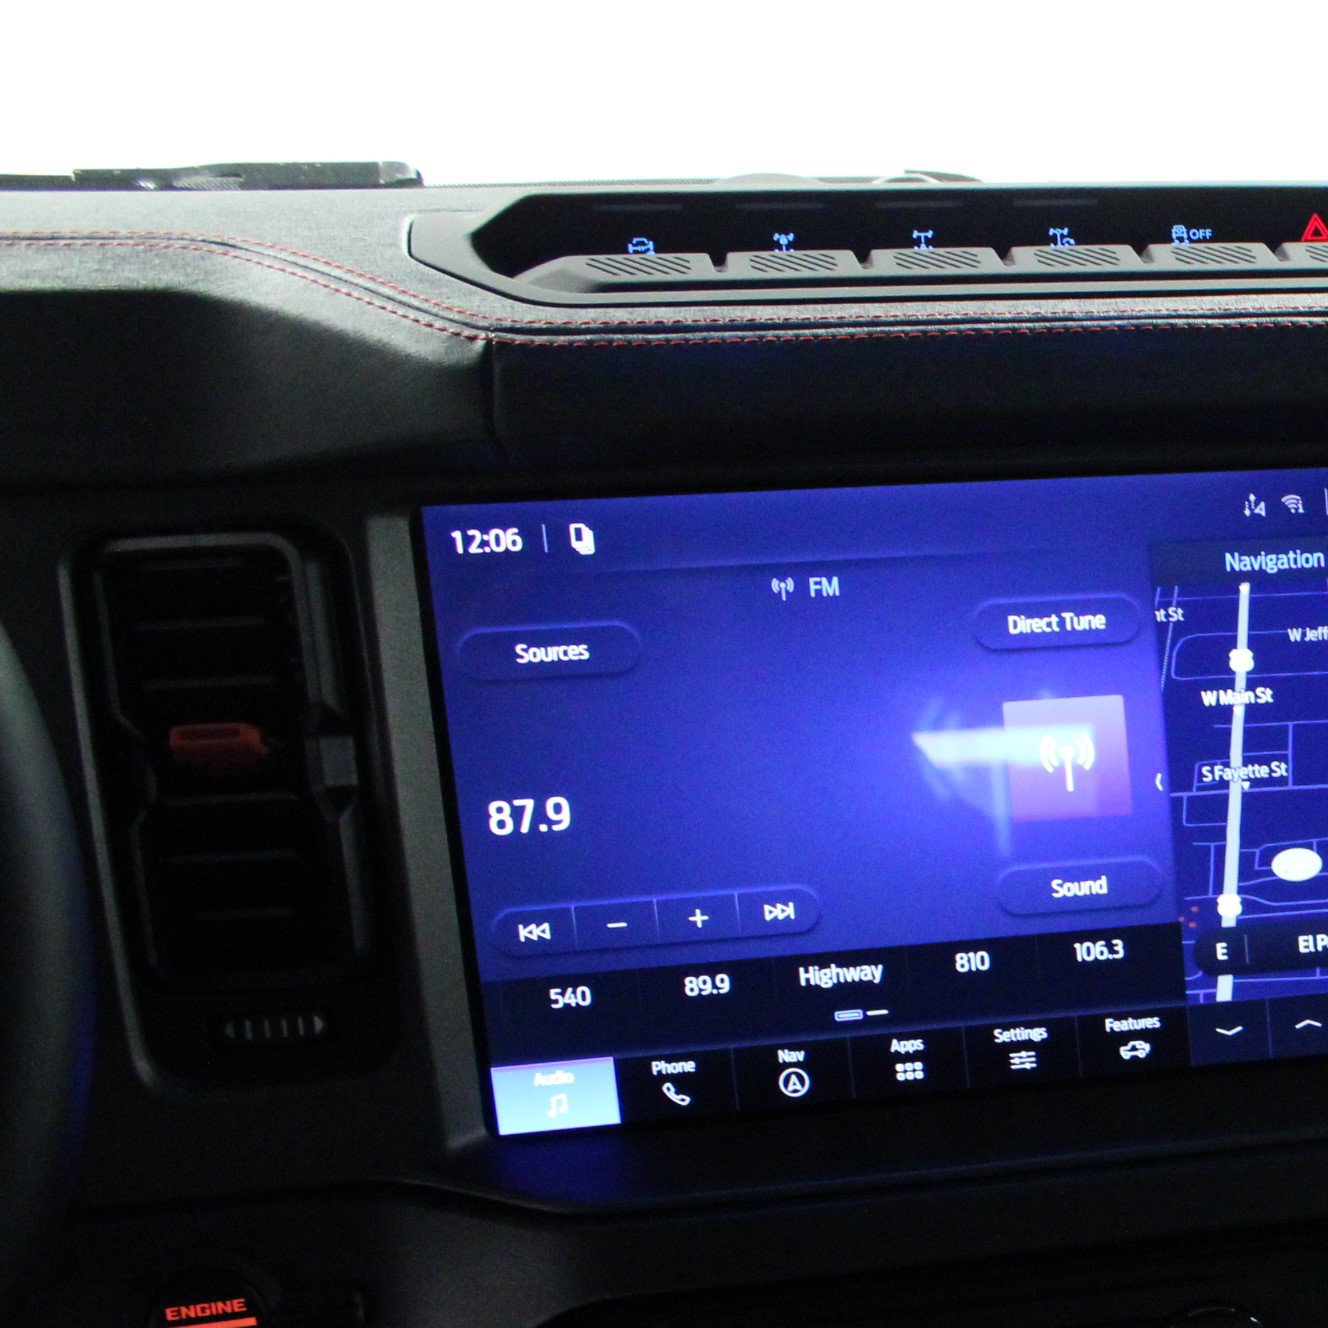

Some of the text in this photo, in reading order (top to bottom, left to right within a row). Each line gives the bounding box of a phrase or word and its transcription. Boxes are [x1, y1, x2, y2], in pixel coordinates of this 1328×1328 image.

[1189, 229, 1213, 240] OFF
[450, 527, 523, 555] 12:06
[1225, 551, 1325, 574] Navigation
[809, 576, 840, 598] FM
[1007, 611, 1107, 635] Direct Tune
[1168, 607, 1185, 621] St
[1287, 628, 1302, 642] W
[515, 642, 590, 663] Sources
[1200, 687, 1274, 707] W Main St
[1202, 761, 1288, 783] S Fayette St
[488, 796, 571, 836] 87.9
[1051, 876, 1108, 898] Sound
[1073, 939, 1124, 962] 106.3
[1216, 942, 1228, 961] E
[1297, 935, 1315, 953] El
[955, 950, 990, 973] 810
[684, 973, 731, 997] 89.9
[799, 961, 883, 989] Highway
[549, 986, 592, 1010] 540
[993, 1024, 1047, 1044] Settings
[1104, 1015, 1161, 1034] Features
[777, 1046, 805, 1064] Nav
[890, 1035, 925, 1055] Apps
[652, 1058, 696, 1077] Phone
[164, 1298, 247, 1321] ENGINE
